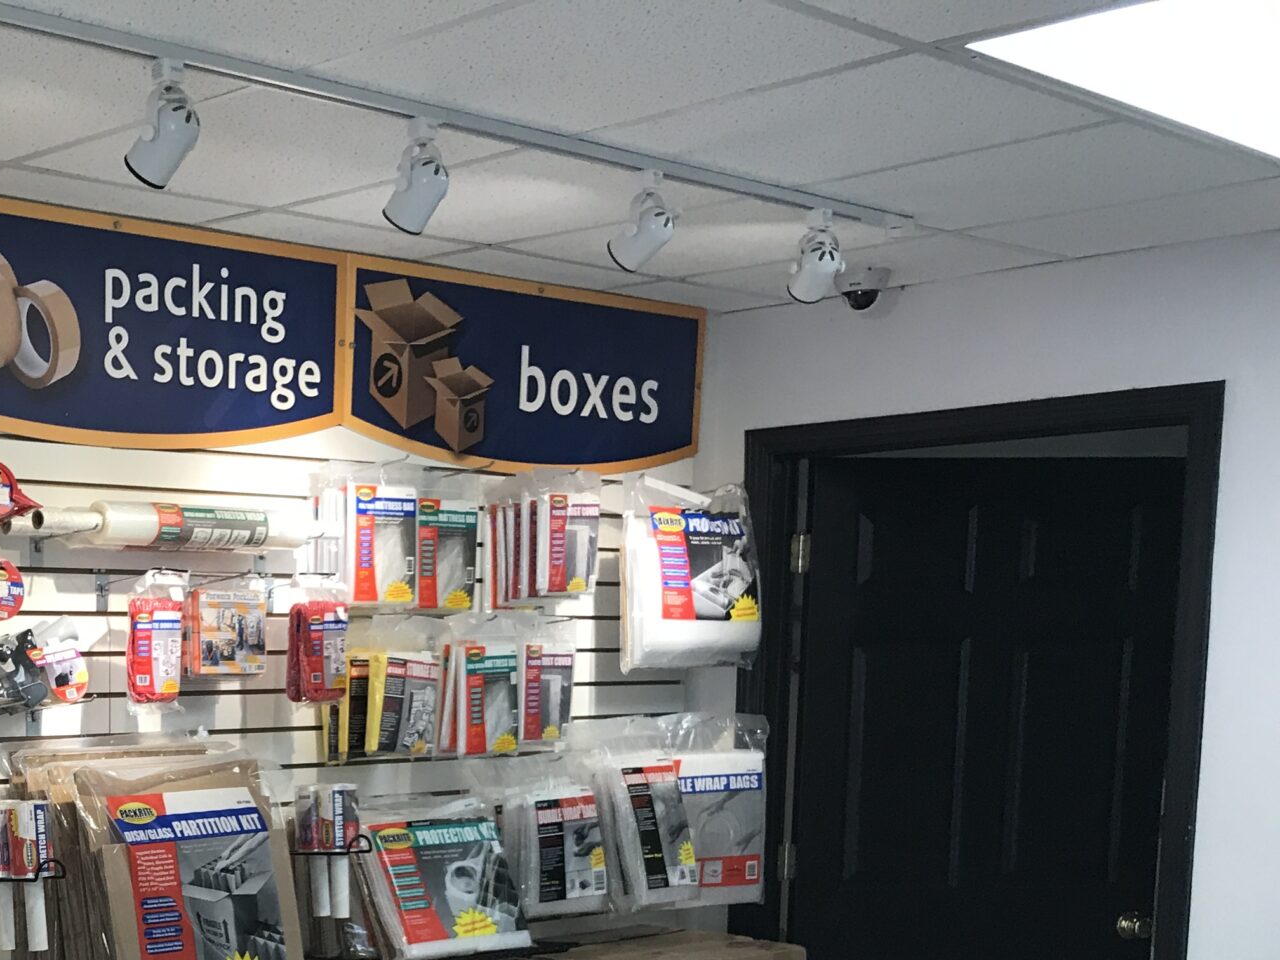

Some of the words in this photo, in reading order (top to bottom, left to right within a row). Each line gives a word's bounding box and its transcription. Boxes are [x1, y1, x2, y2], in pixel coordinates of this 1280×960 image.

[104, 265, 287, 343] packing
[104, 329, 138, 380] &
[153, 336, 321, 410] storage
[520, 344, 660, 425] boxes
[694, 776, 727, 792] WRAP
[729, 774, 759, 790] BAGS
[119, 808, 155, 820] PACKRITE
[171, 816, 241, 838] PARTITION
[240, 813, 262, 831] KIT
[415, 826, 481, 845] PROTECTION
